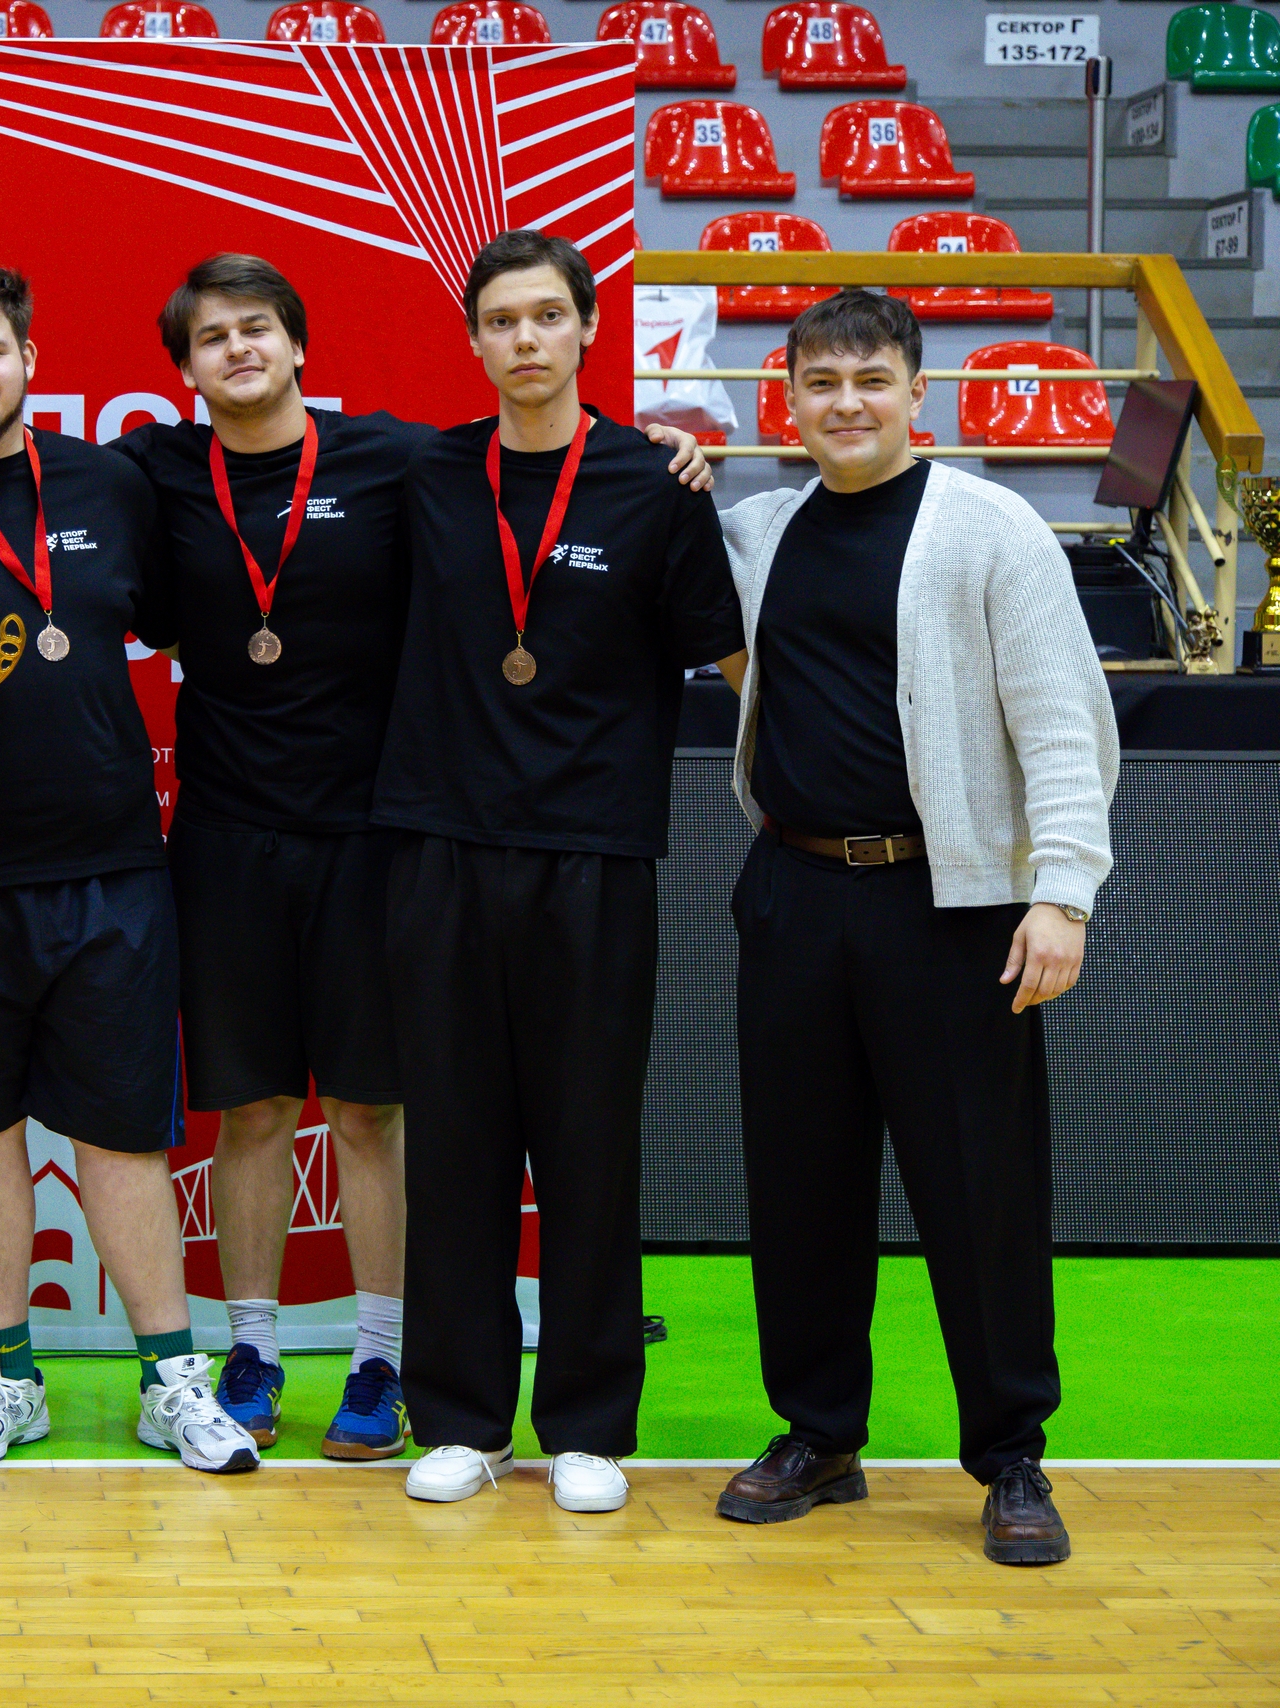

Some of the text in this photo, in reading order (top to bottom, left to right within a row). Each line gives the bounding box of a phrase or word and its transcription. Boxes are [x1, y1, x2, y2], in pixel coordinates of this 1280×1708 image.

[146, 16, 169, 35] 44
[313, 20, 336, 39] 45
[478, 22, 502, 41] 46
[644, 22, 666, 41] 47
[811, 22, 833, 40] 48
[997, 18, 1084, 34] СЕКТОР Г
[998, 45, 1087, 61] 135-172
[696, 124, 721, 143] 35
[871, 122, 895, 142] 36
[306, 498, 337, 506] СПОРТ
[306, 511, 345, 519] ПЕРВЫХ
[60, 530, 87, 538] СПОРТ
[63, 542, 98, 551] ПЕРВЫХ
[571, 545, 603, 556] СПОРТ
[570, 553, 596, 562] ФЕСТ
[568, 560, 609, 572] ПЕРВЫХ
